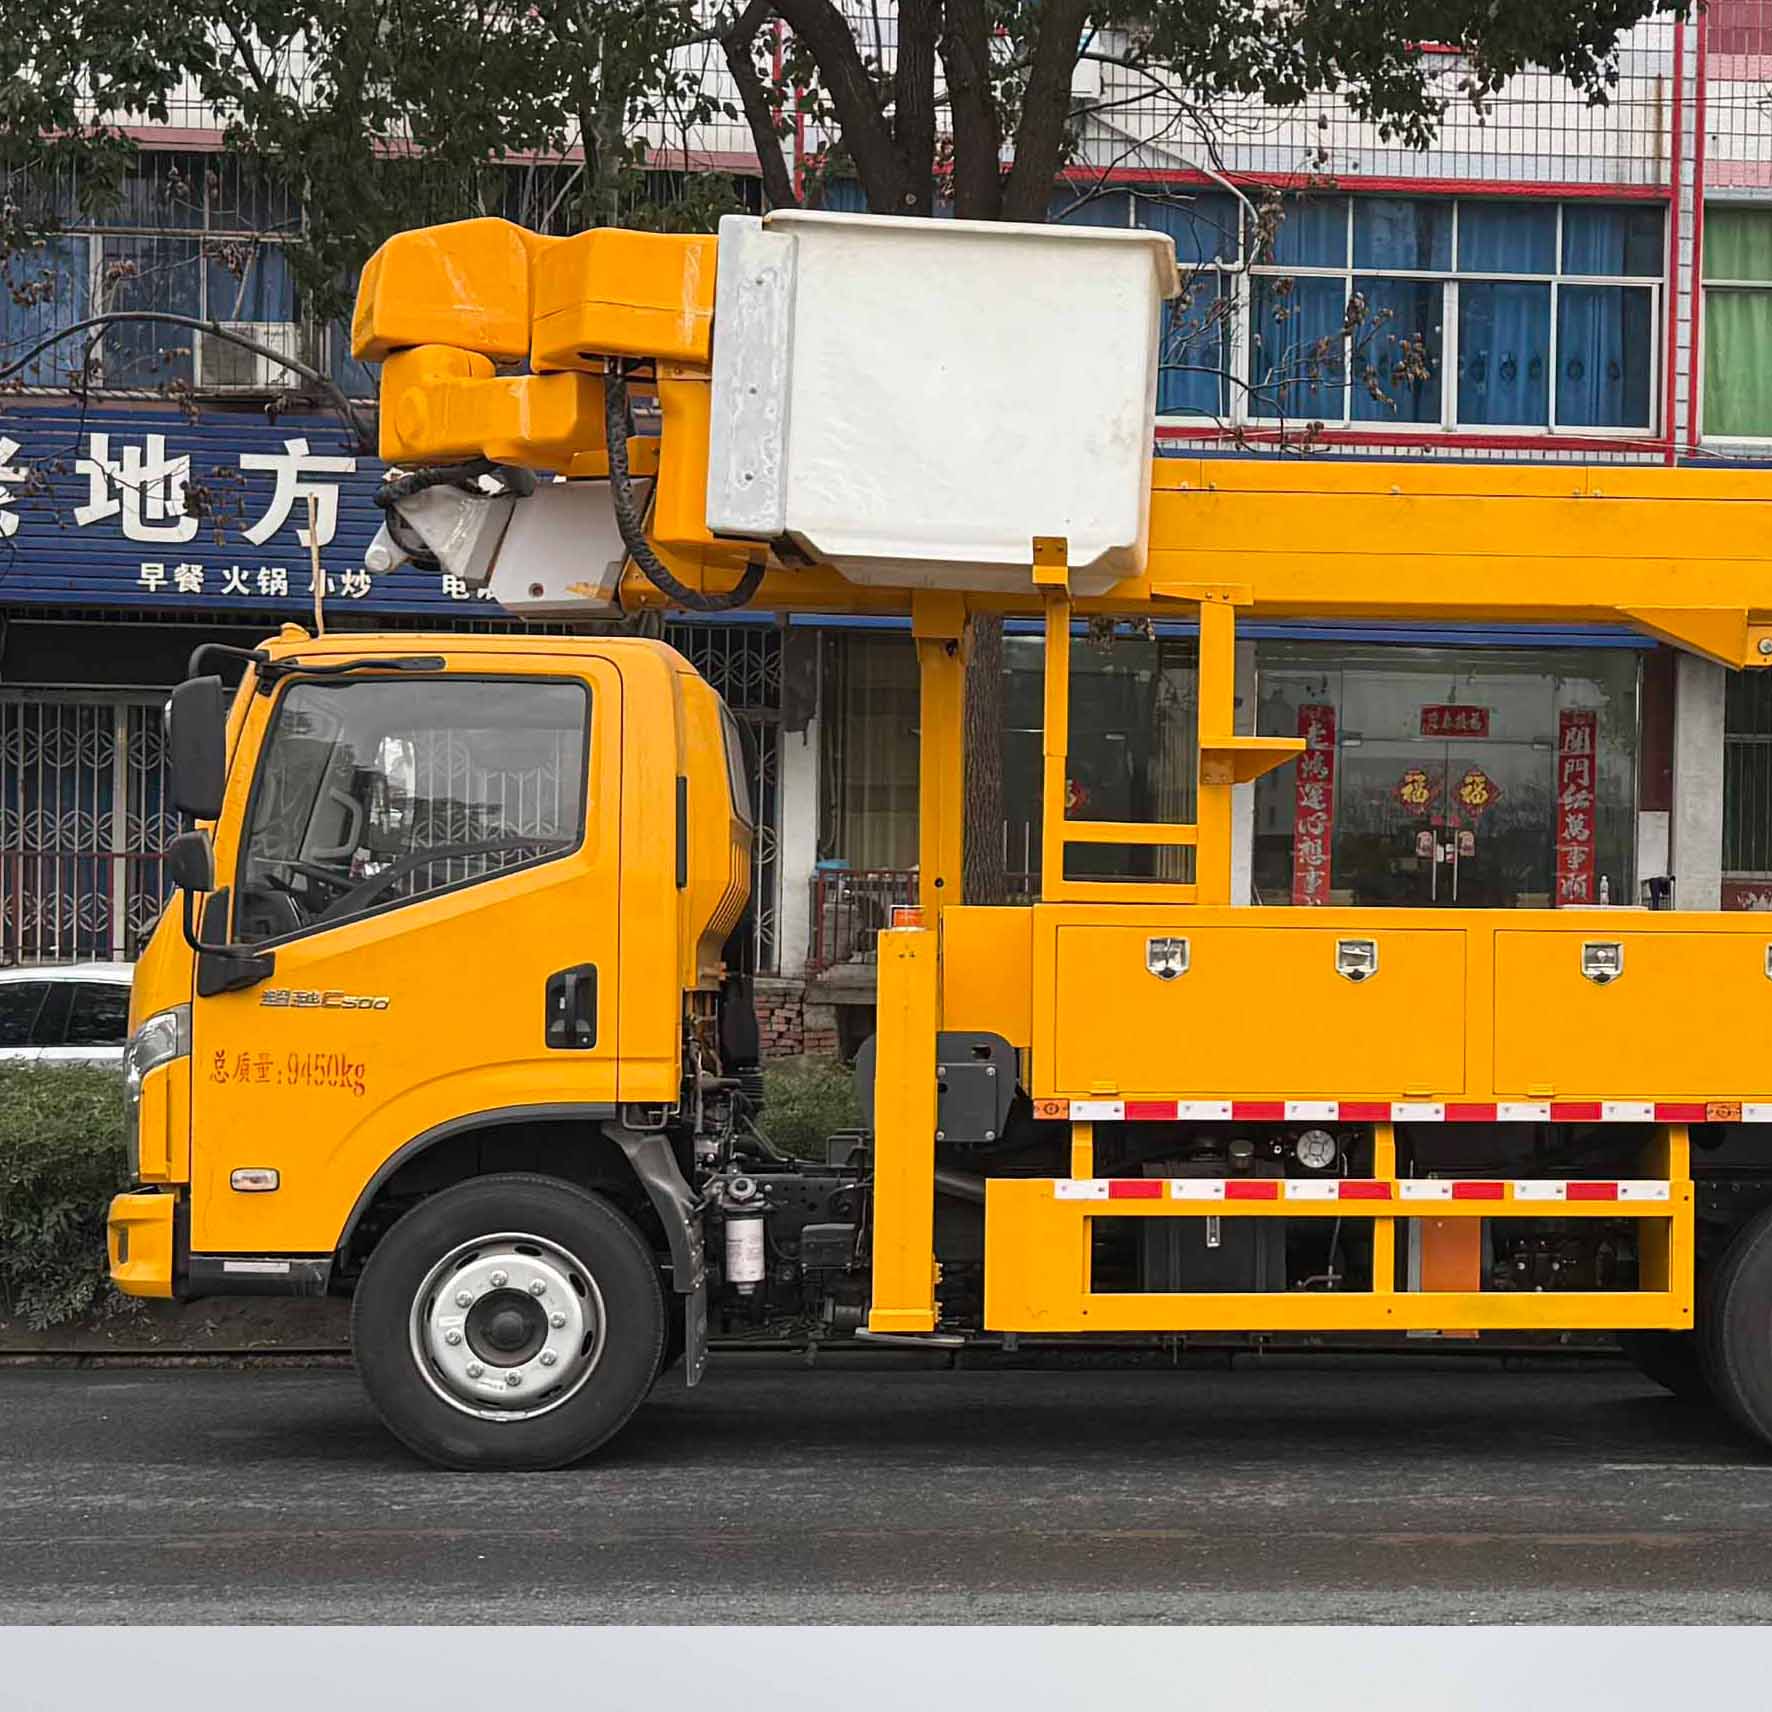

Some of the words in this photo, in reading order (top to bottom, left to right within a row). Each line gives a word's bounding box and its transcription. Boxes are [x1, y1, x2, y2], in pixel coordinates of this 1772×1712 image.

[137, 562, 204, 593] 早餐
[221, 566, 288, 596] 火锅
[1401, 771, 1430, 804] 福
[1459, 775, 1489, 805] 福
